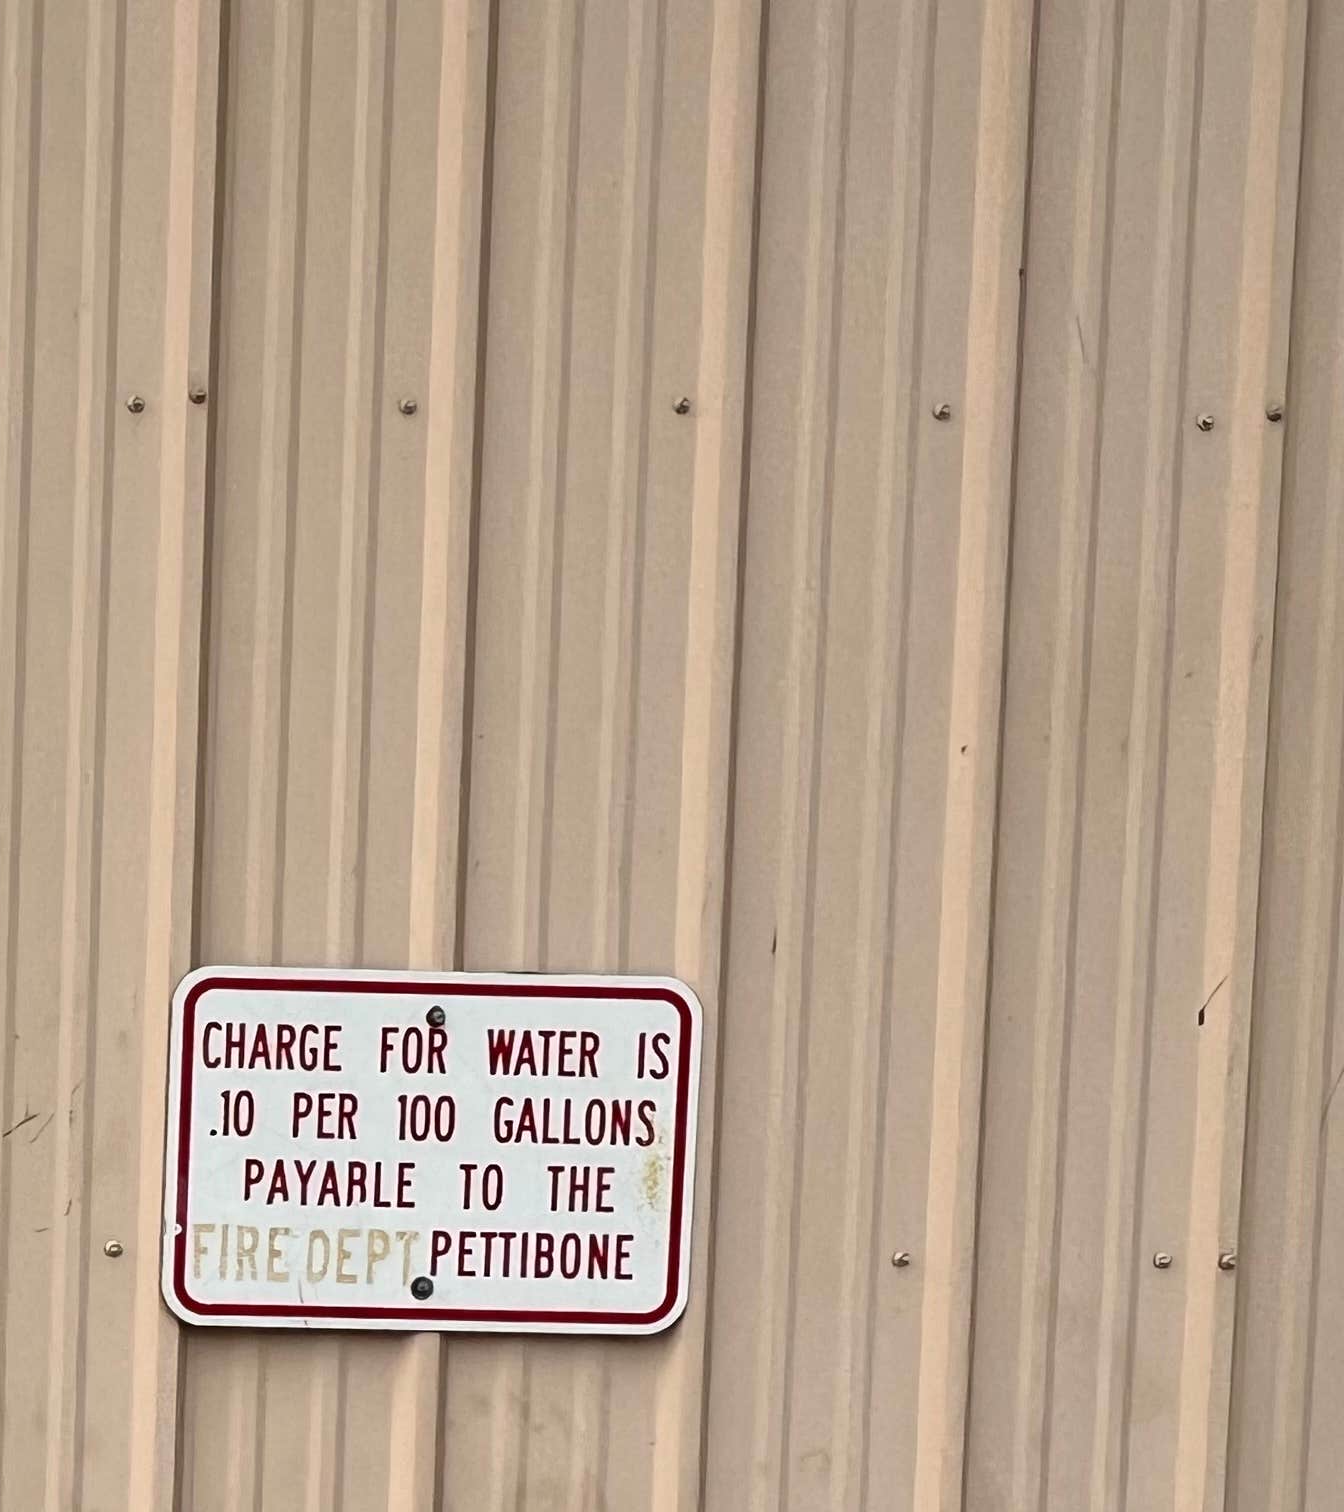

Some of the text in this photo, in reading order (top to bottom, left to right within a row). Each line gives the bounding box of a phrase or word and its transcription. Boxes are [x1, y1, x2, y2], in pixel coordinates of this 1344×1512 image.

[203, 1022, 670, 1079] CHARGE FOR WATER IS
[210, 1091, 656, 1146] .10 PER 100 GALLONS
[244, 1159, 615, 1212] PAYABLE TO THE
[193, 1224, 633, 1286] FIRE DEPT PETTIBONE
